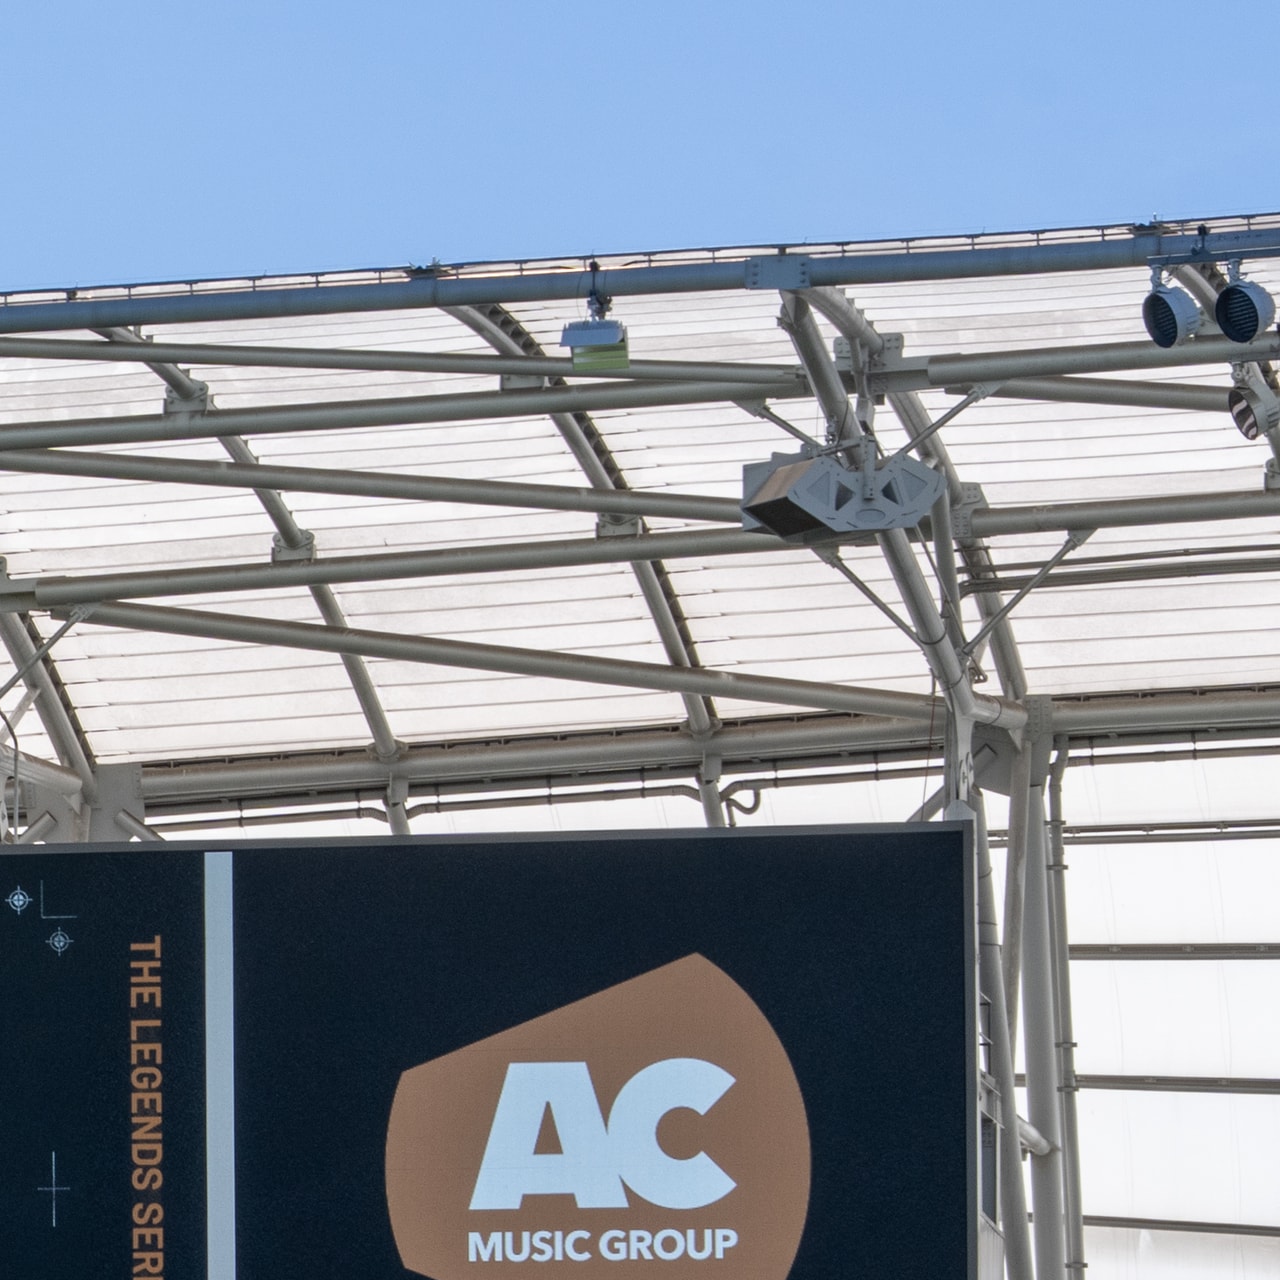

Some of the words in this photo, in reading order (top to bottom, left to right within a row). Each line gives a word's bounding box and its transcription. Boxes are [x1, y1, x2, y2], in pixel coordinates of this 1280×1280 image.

[130, 935, 161, 1008] THE
[131, 1020, 163, 1190] LEGENDS
[469, 1058, 737, 1210] AC
[469, 1230, 591, 1262] MUSIC
[599, 1229, 738, 1260] GROUP
